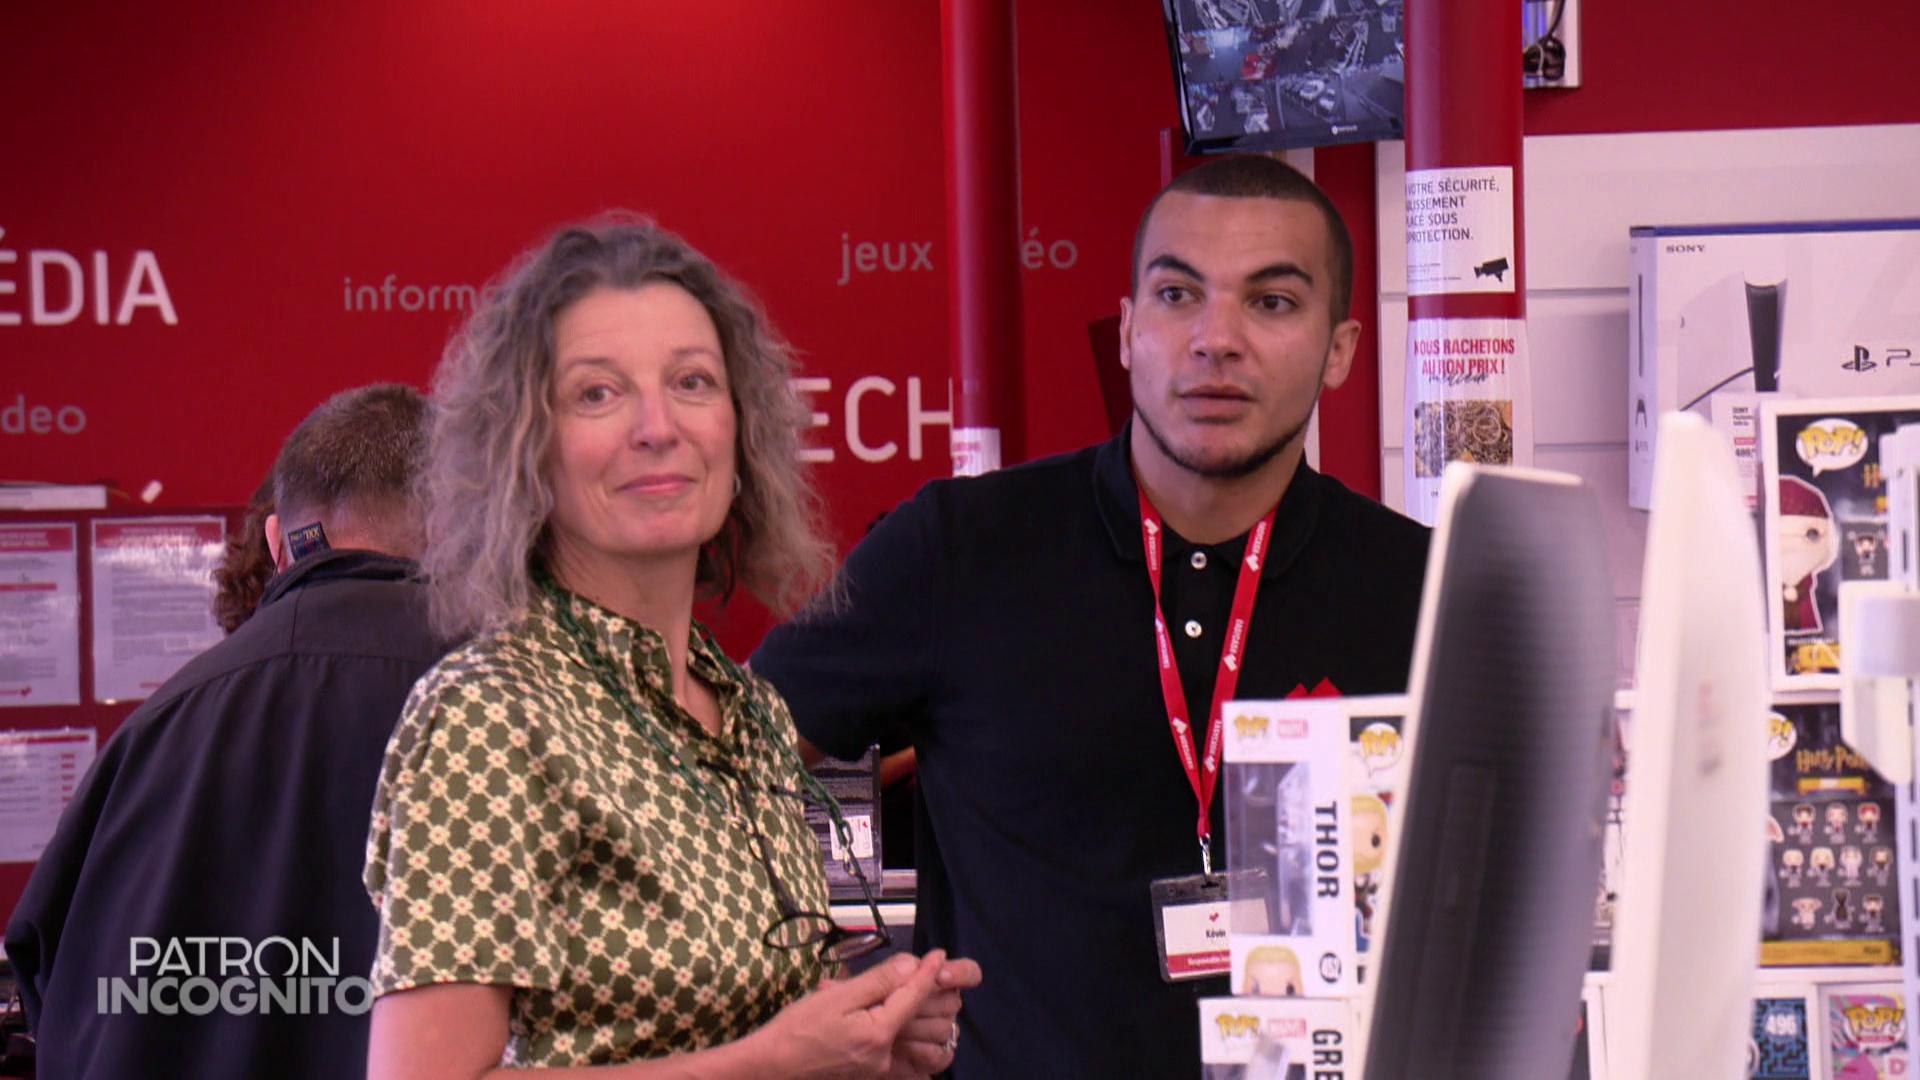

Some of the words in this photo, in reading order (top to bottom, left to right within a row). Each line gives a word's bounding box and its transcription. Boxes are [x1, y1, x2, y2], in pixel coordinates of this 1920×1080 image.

[1438, 176, 1500, 193] SÉCURITÉ,
[1428, 211, 1458, 226] SOUS
[1666, 244, 1705, 253] SONY
[837, 233, 934, 286] jeux
[1414, 339, 1440, 355] NOUS
[1443, 338, 1515, 354] RACHETONS
[1422, 360, 1435, 374] AU
[1468, 359, 1498, 375] PRIX
[1797, 426, 1866, 459] POP!
[1315, 801, 1340, 899] THOR
[1843, 1005, 1905, 1036] POP!
